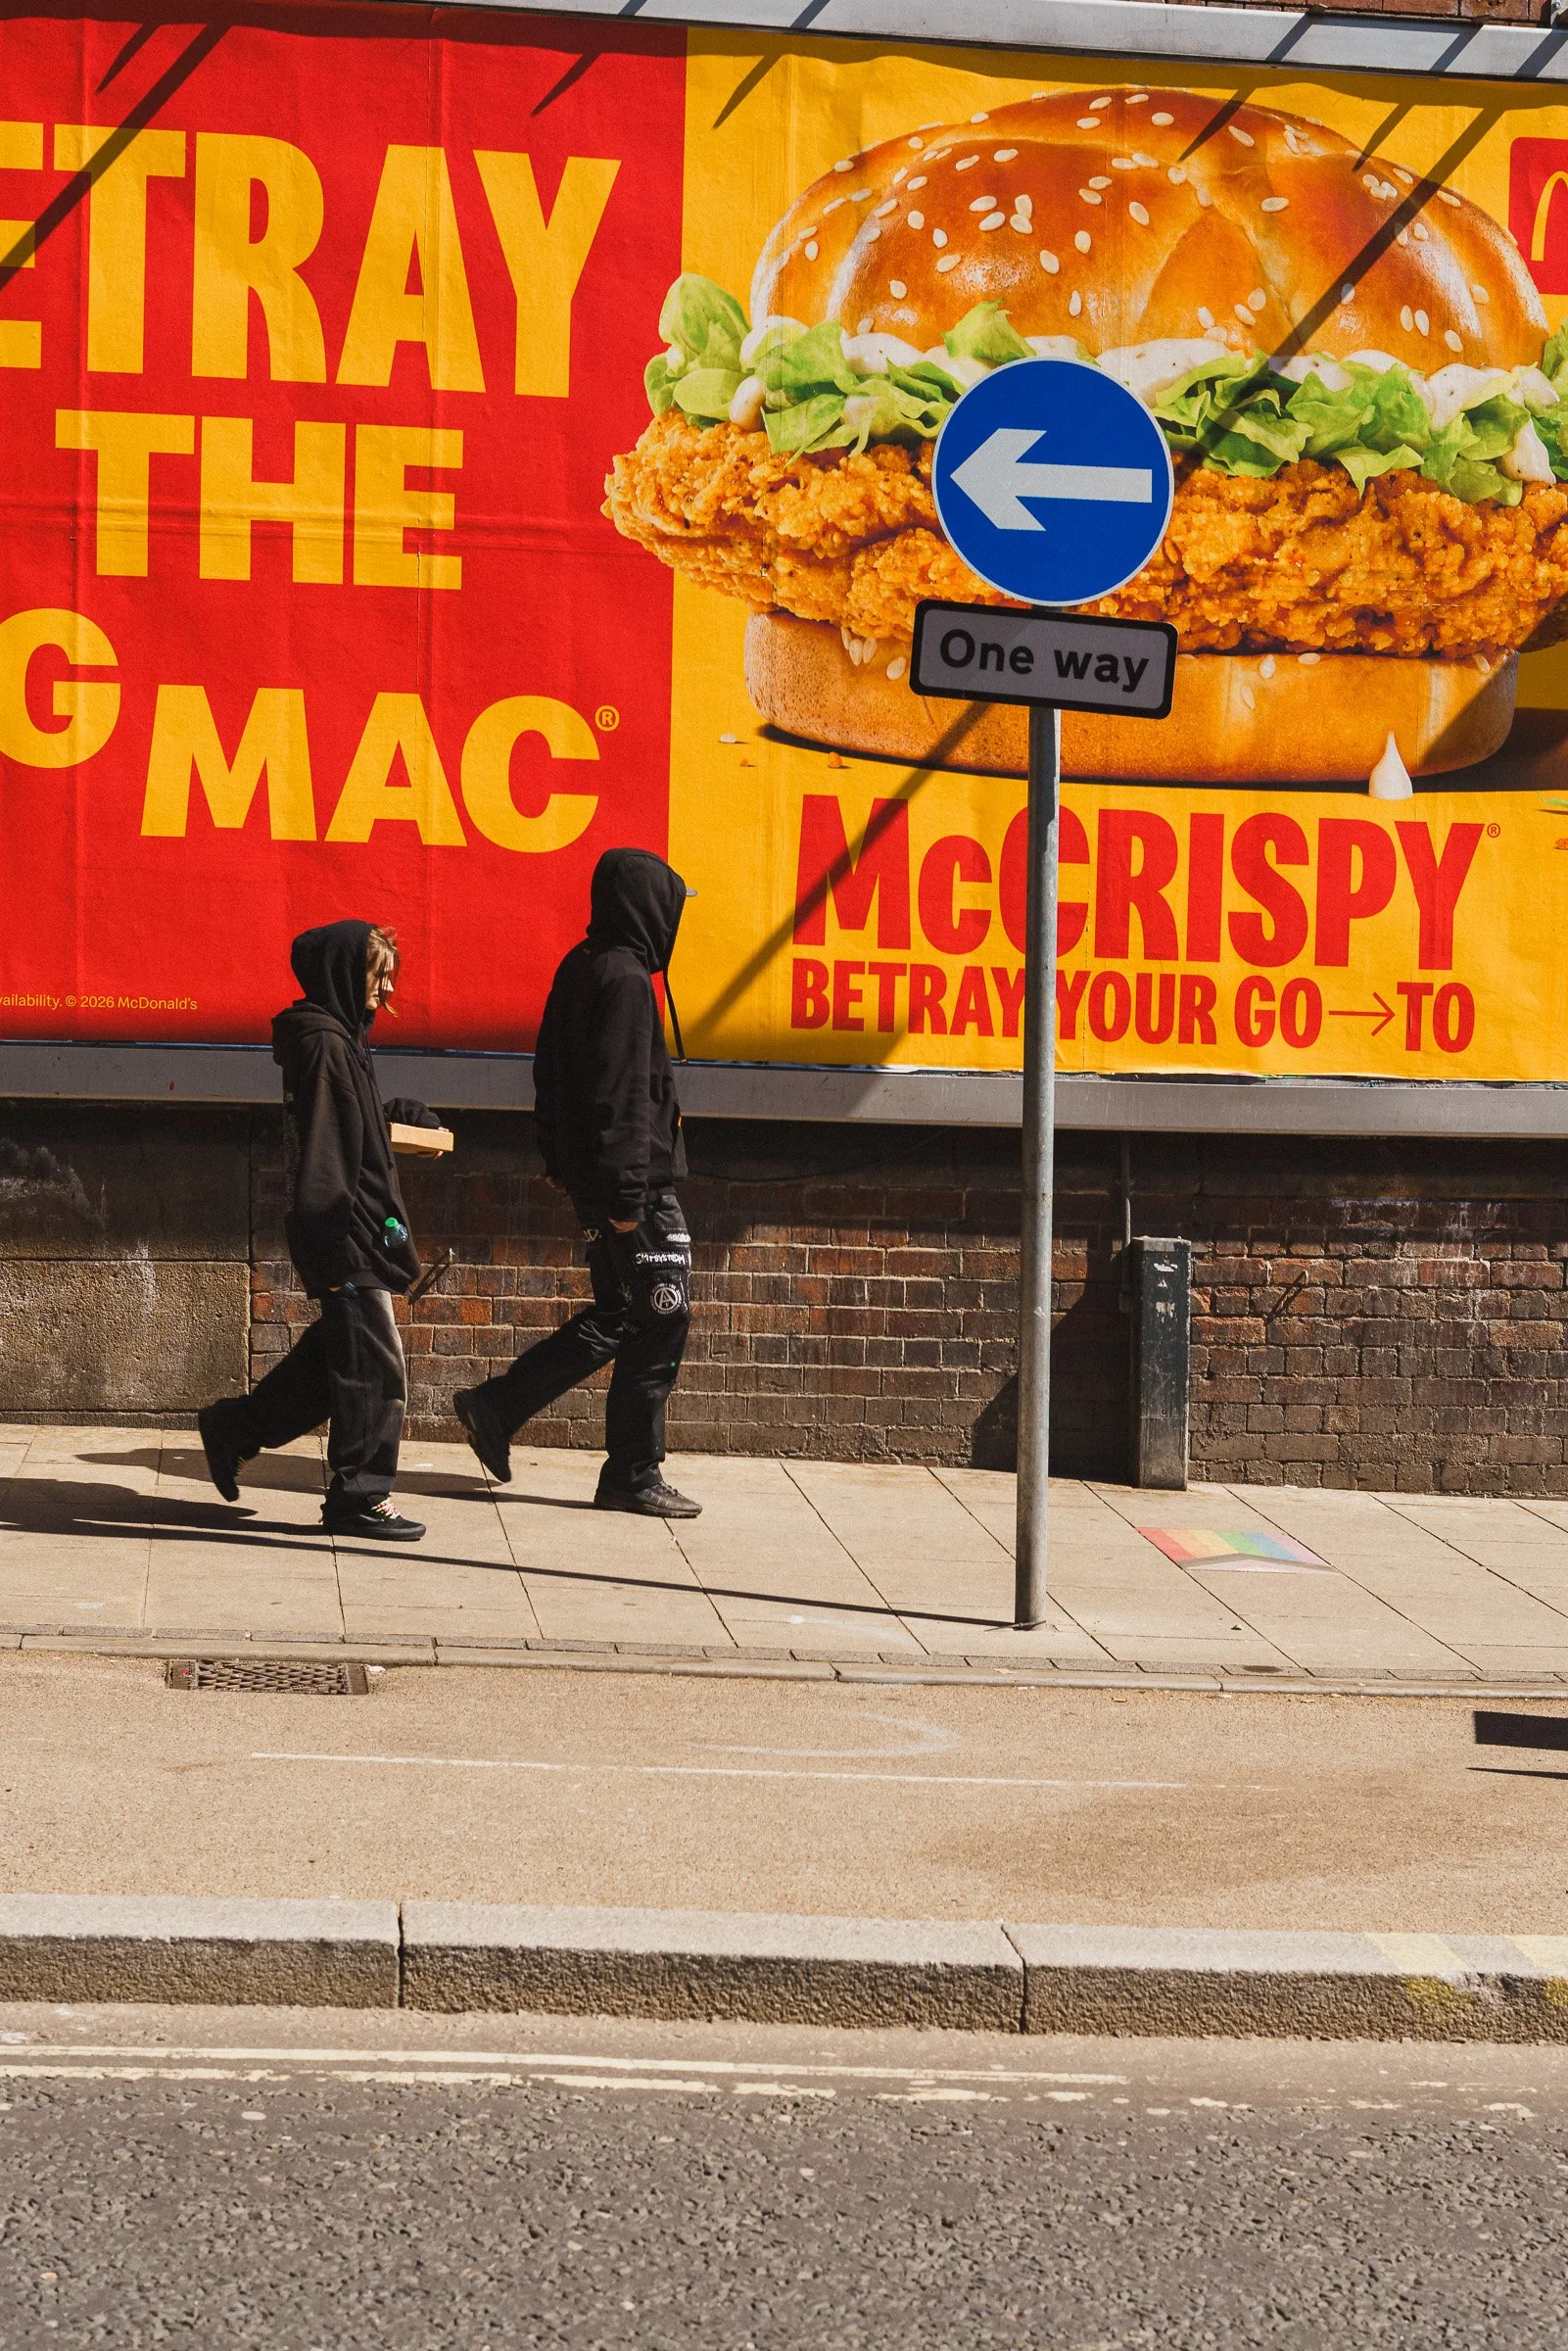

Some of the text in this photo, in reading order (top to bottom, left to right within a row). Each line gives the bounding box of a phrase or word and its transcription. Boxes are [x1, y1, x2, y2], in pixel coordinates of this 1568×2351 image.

[55, 409, 463, 590] THE
[939, 628, 1150, 693] One way
[80, 995, 116, 1009] 2026
[117, 996, 198, 1011] McDonald's
[791, 959, 1475, 1052] BETRAY YOUR GO TO
